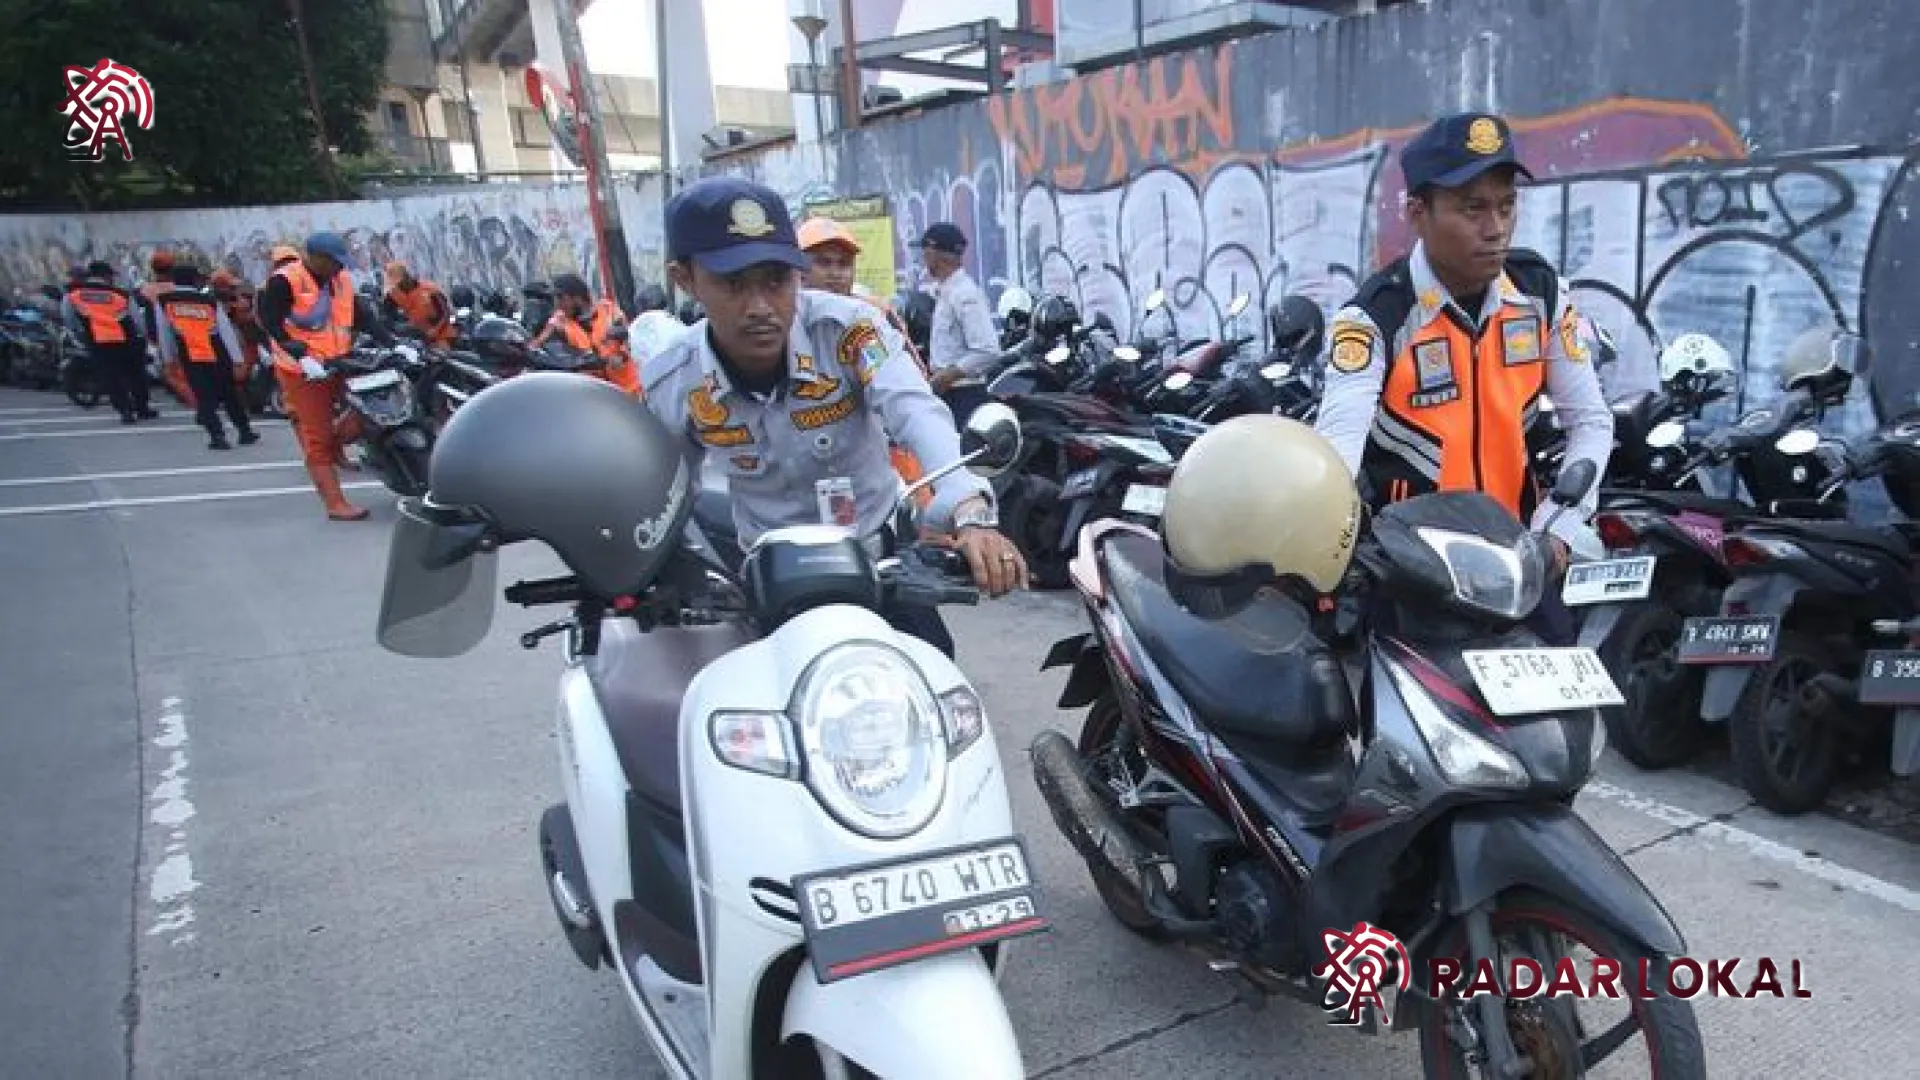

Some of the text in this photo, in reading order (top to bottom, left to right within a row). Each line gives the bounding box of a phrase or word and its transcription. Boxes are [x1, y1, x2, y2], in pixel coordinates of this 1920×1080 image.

[1473, 654, 1490, 681] F
[1500, 654, 1559, 678] 5768
[813, 852, 1022, 925] B 6740 WTR
